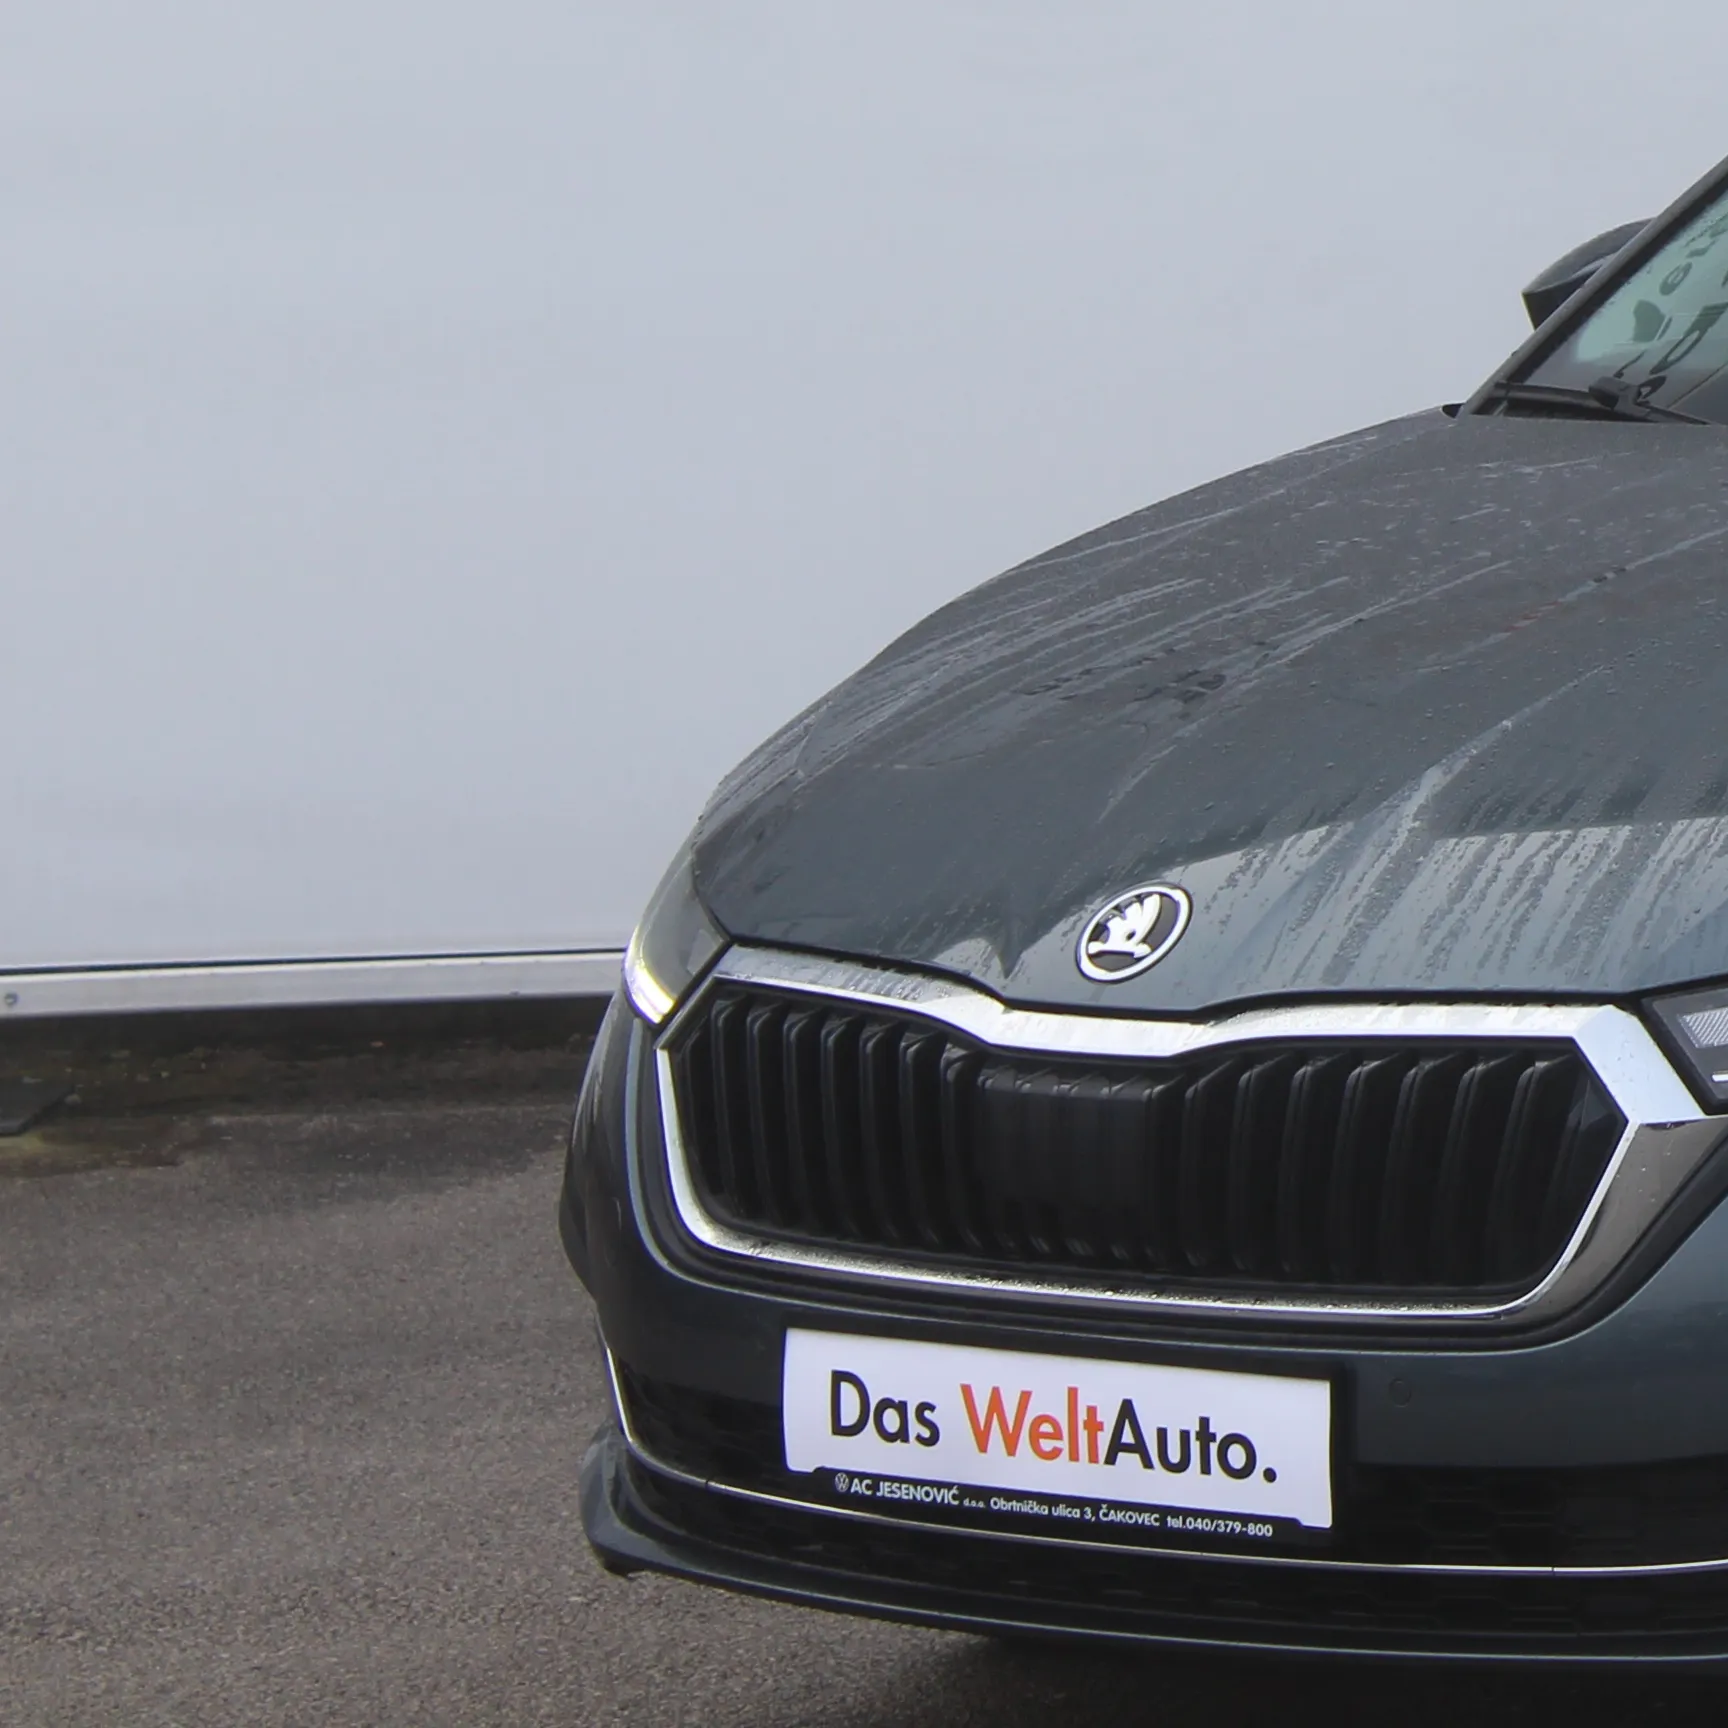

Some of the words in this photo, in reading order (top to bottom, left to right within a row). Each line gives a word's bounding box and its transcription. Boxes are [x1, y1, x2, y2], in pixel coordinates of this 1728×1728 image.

[829, 1368, 941, 1448] Das
[960, 1383, 1278, 1484] WeltAuto.
[850, 1478, 872, 1495] AC
[876, 1481, 960, 1506] JESENOVIĆ
[963, 1498, 986, 1508] d.o.o.
[990, 1497, 1049, 1515] Obrtnička
[1051, 1503, 1081, 1518] ulica
[1083, 1506, 1096, 1522] 3,
[1099, 1503, 1160, 1527] ČAKOVEC
